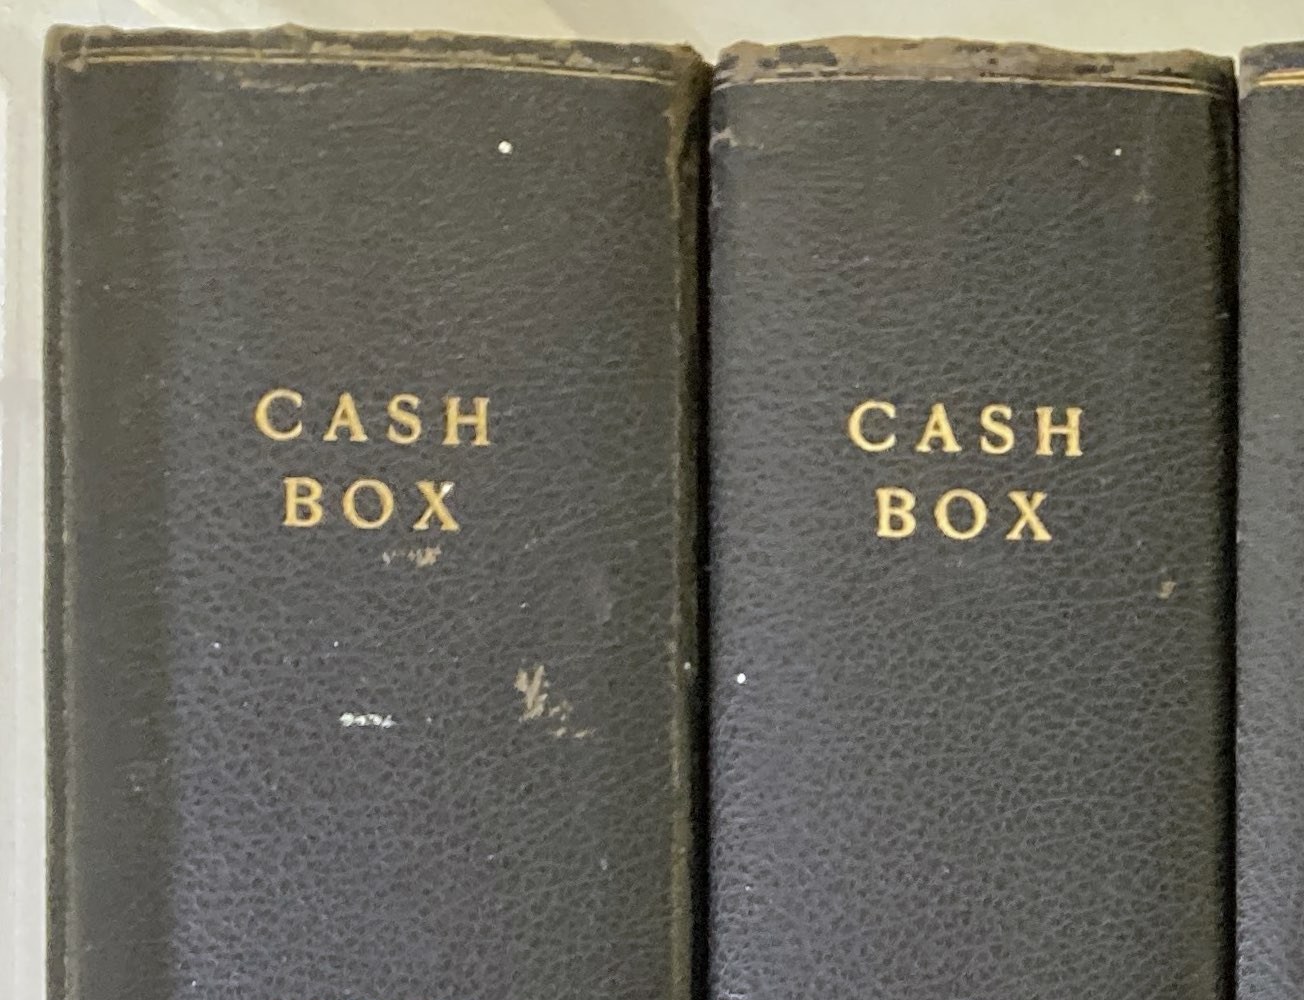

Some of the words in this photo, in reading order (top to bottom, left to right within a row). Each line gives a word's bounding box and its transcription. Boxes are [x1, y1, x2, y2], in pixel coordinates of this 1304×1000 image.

[251, 387, 491, 448] CASH
[844, 398, 1084, 459] CASH
[283, 475, 460, 533] BOX
[874, 484, 1052, 544] BOX
